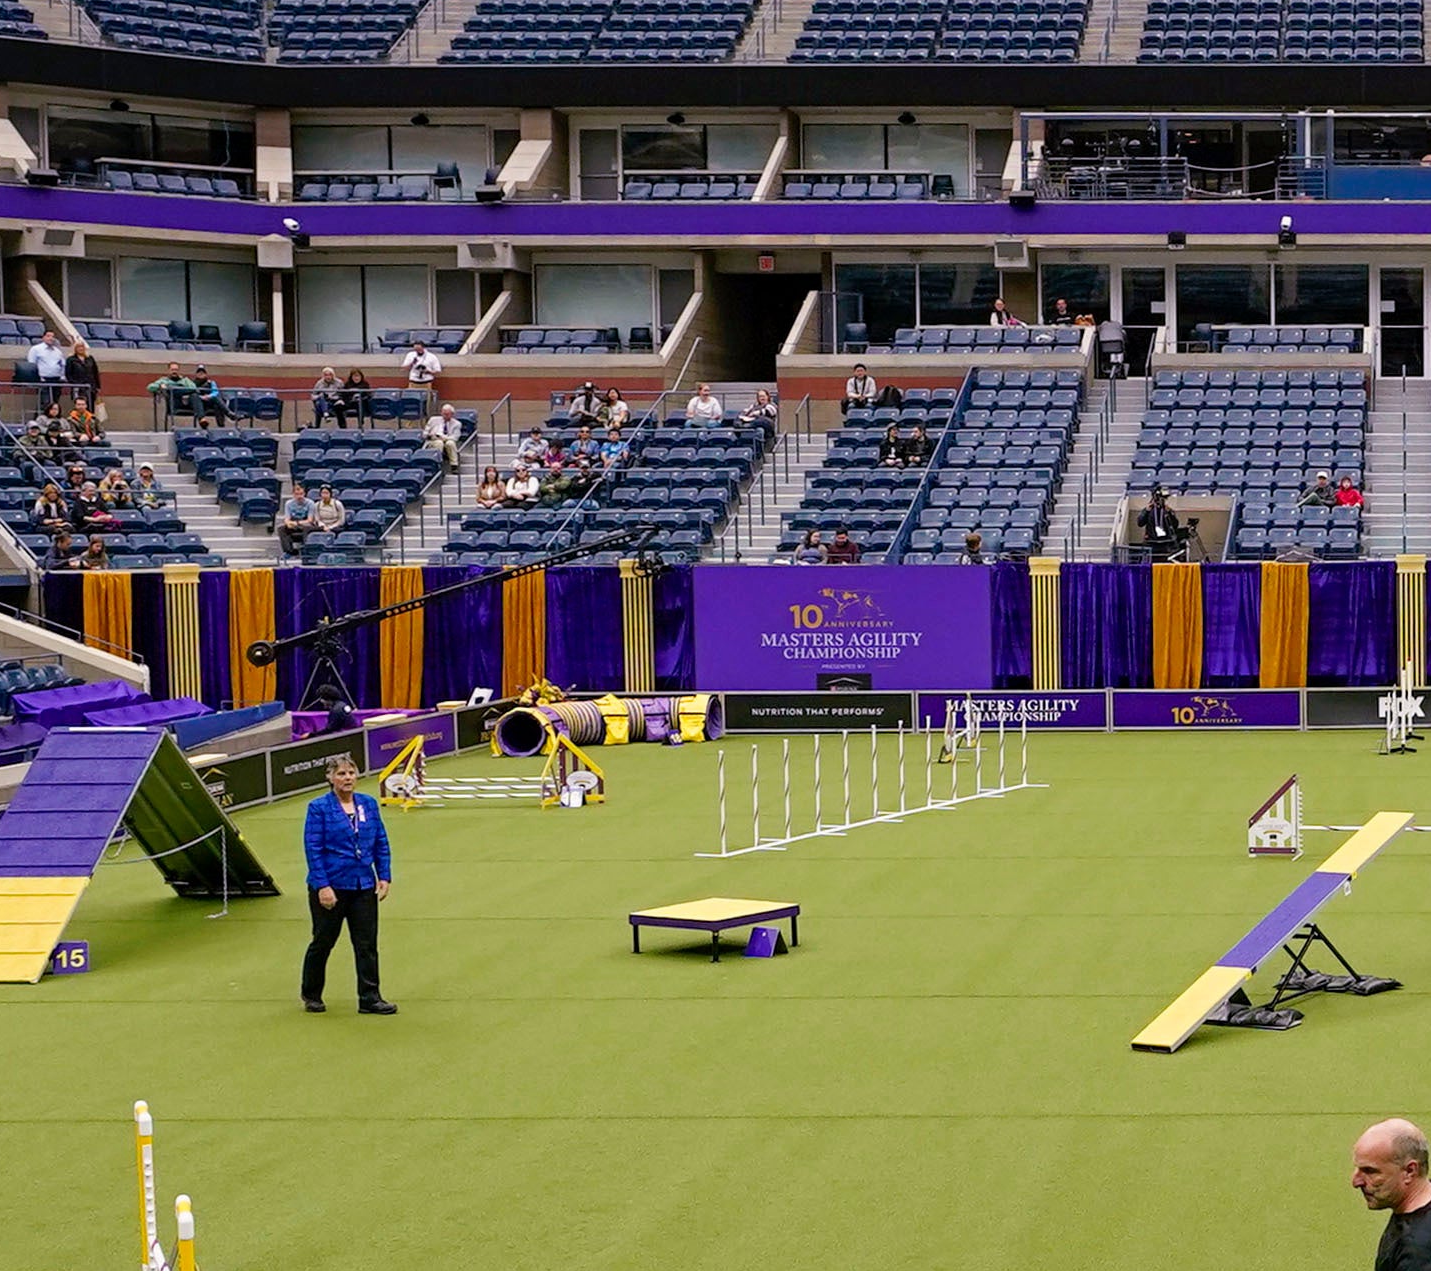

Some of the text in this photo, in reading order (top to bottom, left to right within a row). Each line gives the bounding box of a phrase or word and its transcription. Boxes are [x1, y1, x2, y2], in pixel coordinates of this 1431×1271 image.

[761, 632, 922, 647] MASTERS AGILITY
[783, 647, 901, 660] CHAMPIONSHIP
[751, 708, 803, 716] NUTRITION
[806, 708, 829, 716] THAT
[946, 699, 1079, 712] MASTERS AGILITY
[56, 949, 85, 968] 15
